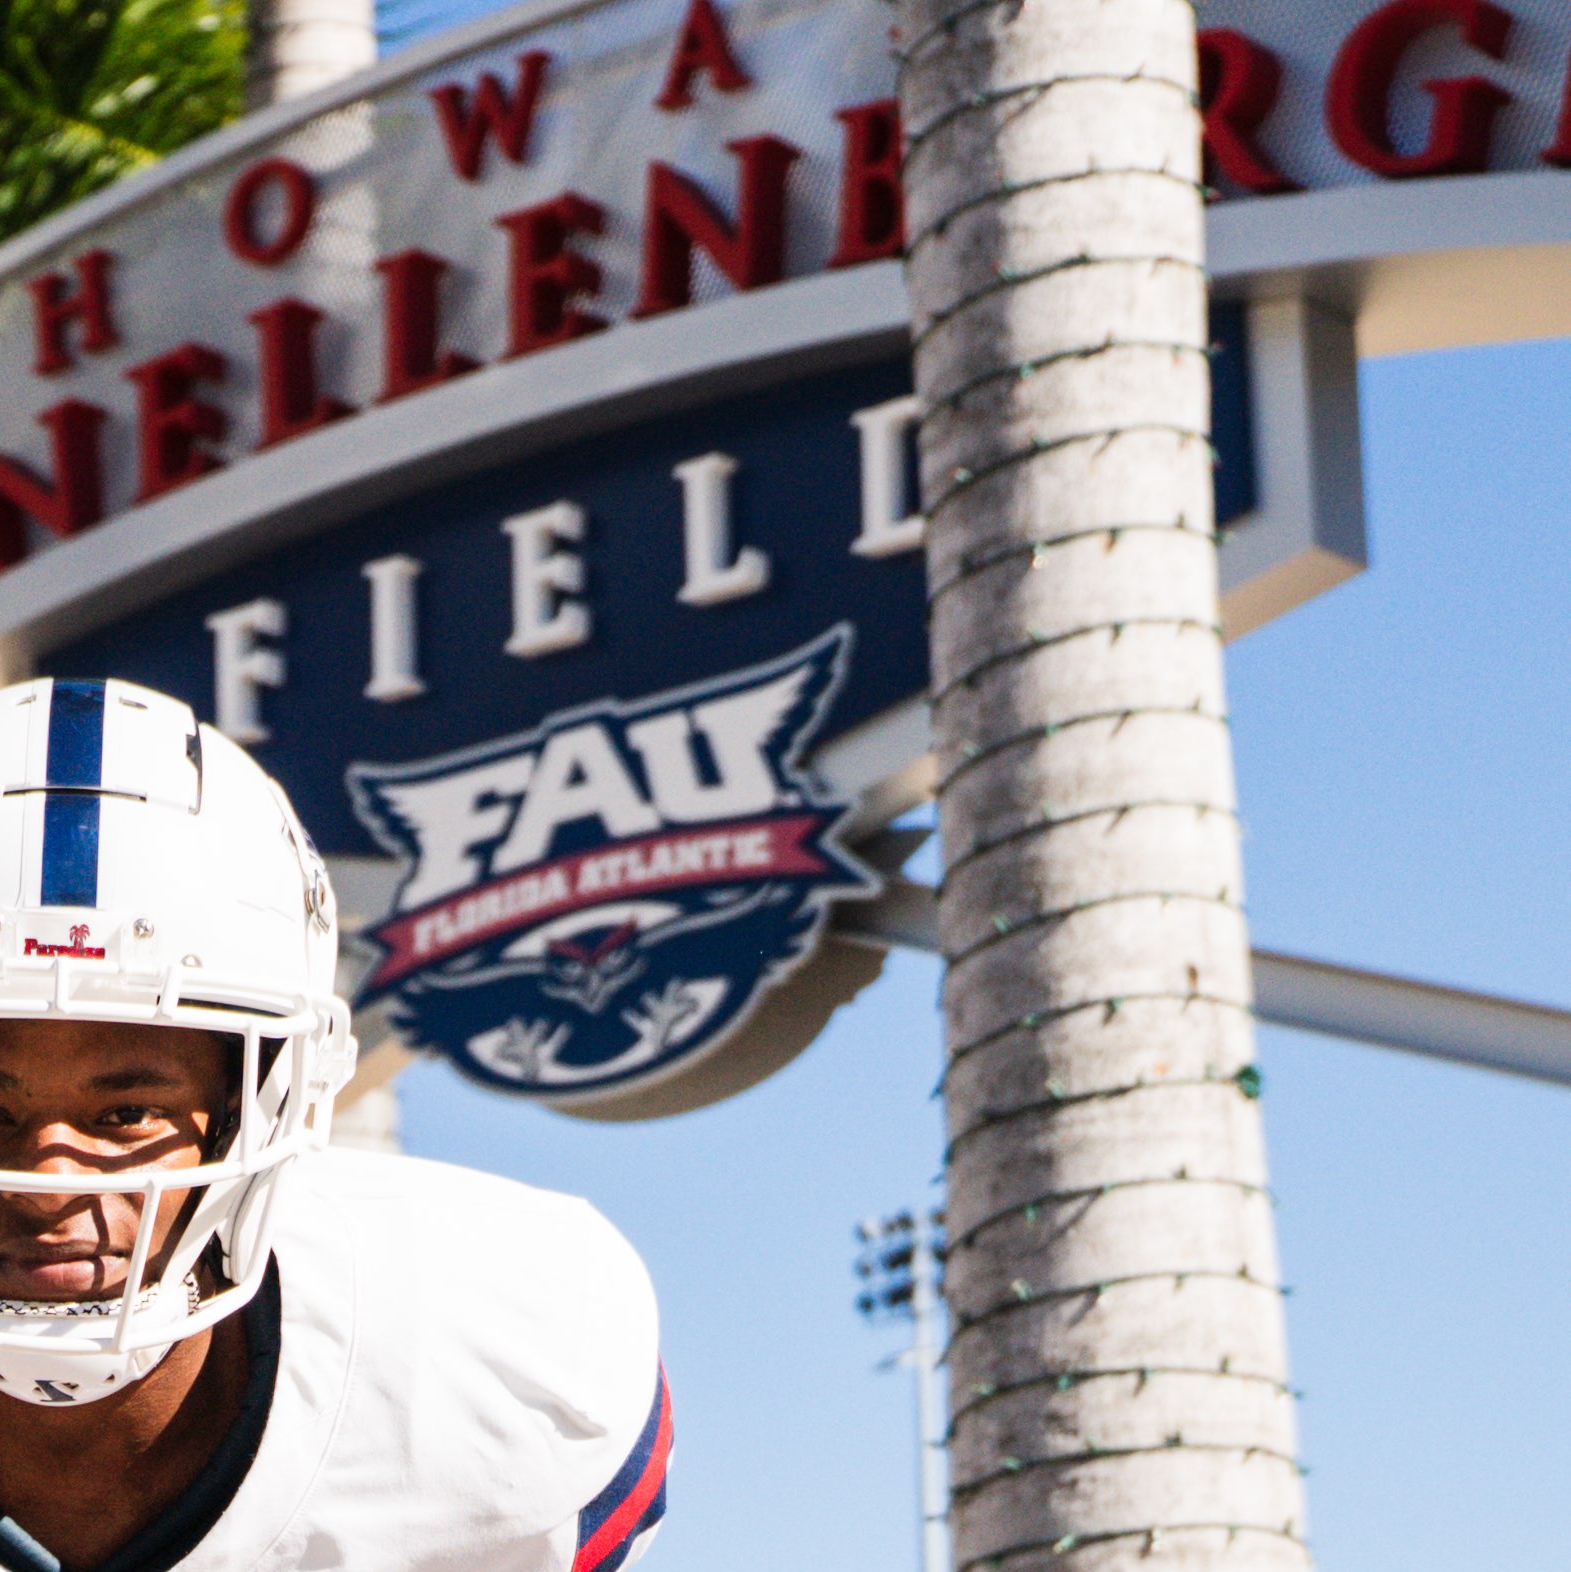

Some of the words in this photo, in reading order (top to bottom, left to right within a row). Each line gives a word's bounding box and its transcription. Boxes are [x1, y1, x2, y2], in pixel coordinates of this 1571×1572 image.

[29, 0, 902, 376] HOWA
[375, 661, 816, 912] FAU
[412, 867, 570, 956] FLORIDA
[575, 828, 774, 895] ATLANTIC
